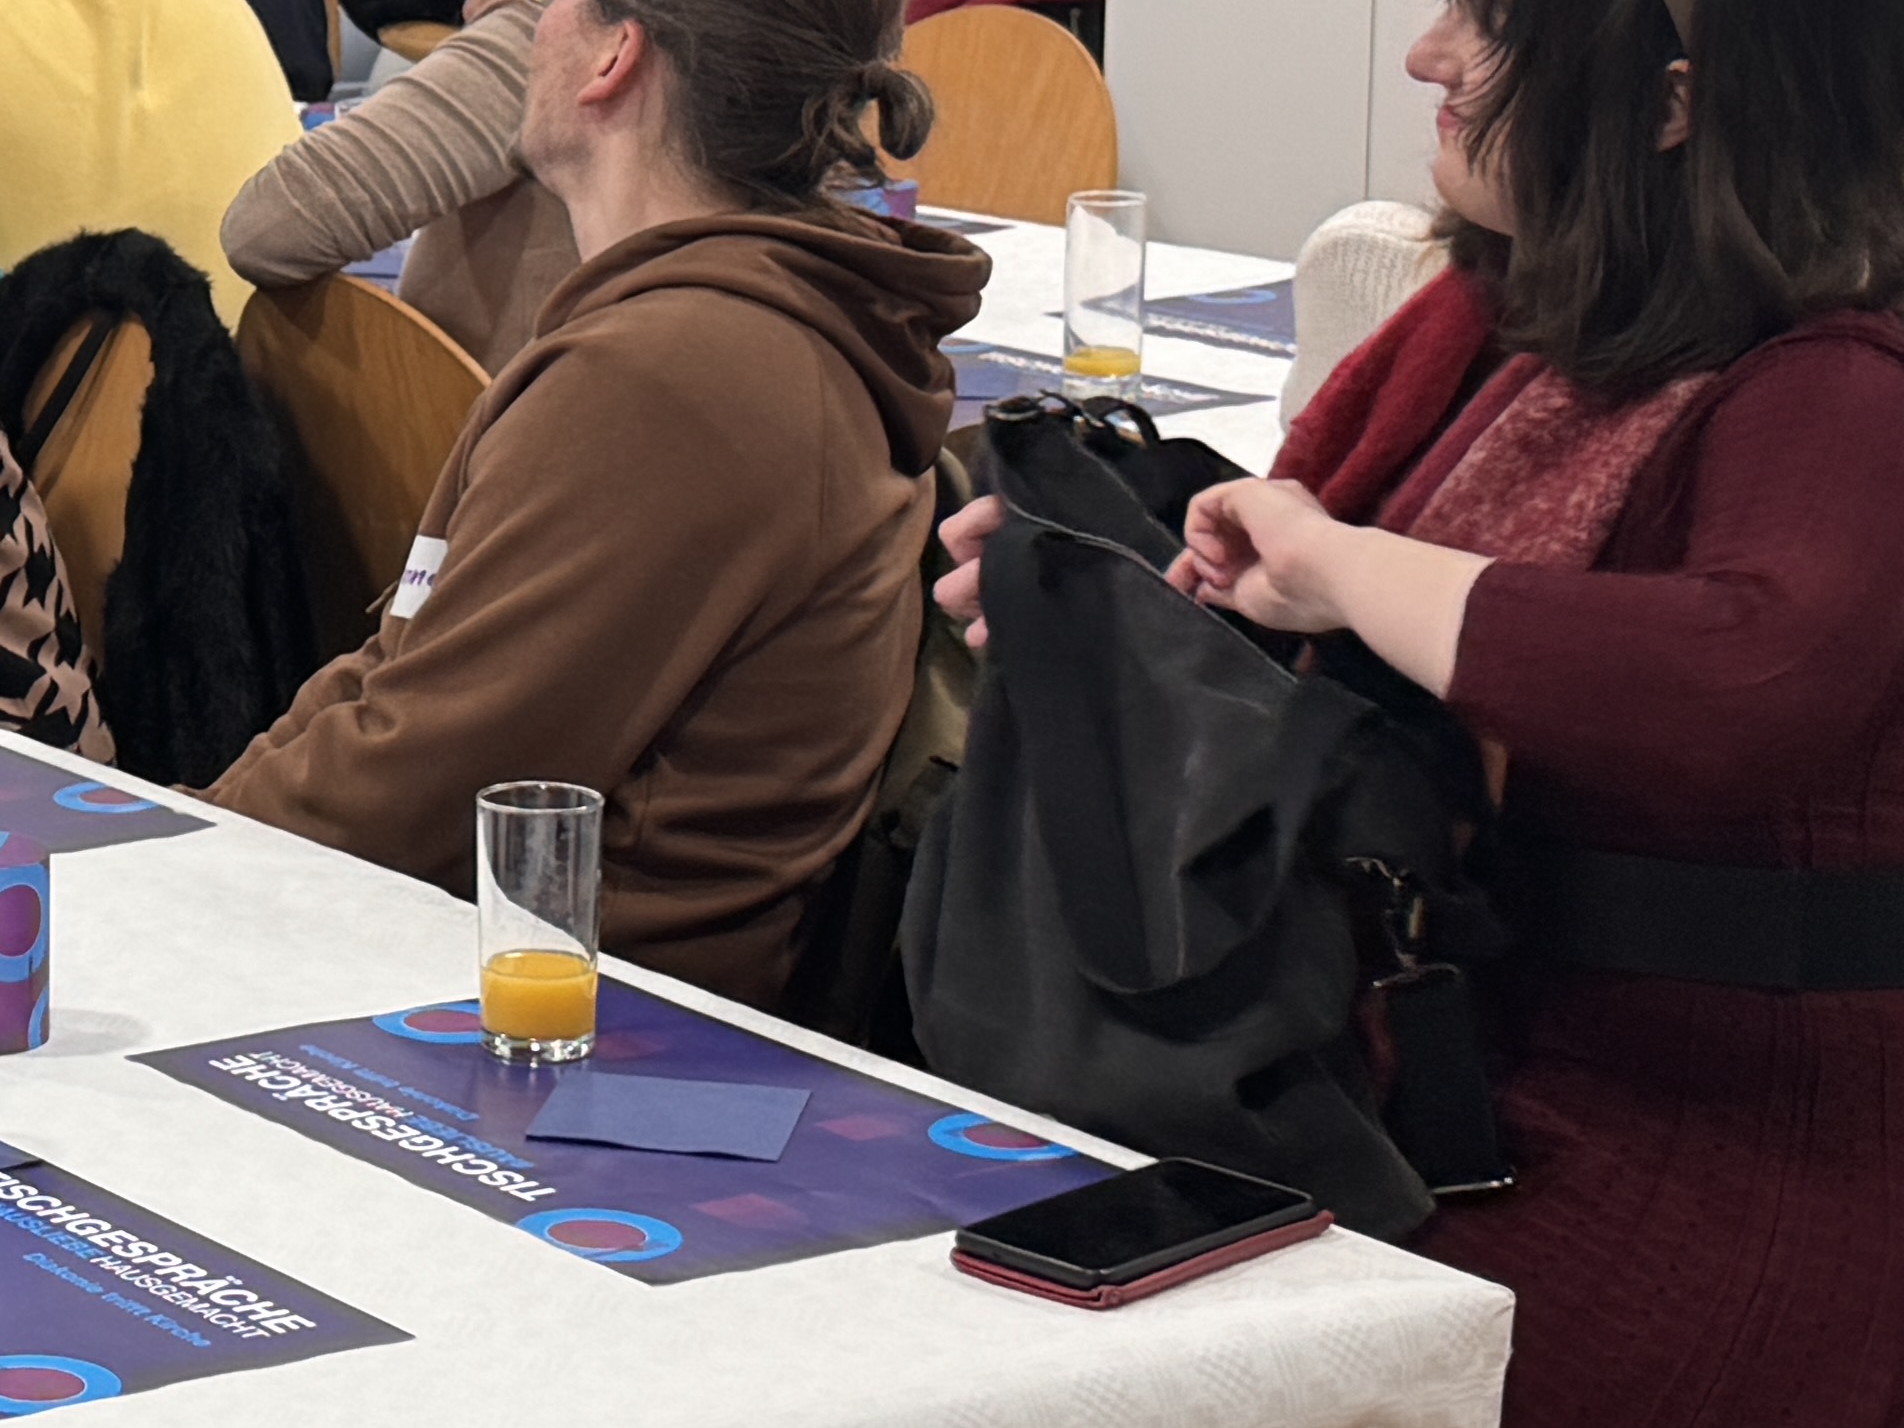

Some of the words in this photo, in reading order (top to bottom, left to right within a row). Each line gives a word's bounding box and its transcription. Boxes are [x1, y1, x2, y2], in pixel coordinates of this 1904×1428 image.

[208, 1053, 557, 1203] TISCHGESPRÄCHE
[251, 1050, 415, 1119] HAUSGEMACHT
[23, 1252, 104, 1295] Diakonie
[144, 1313, 212, 1349] Kirche
[90, 1255, 272, 1339] HAUSGEMACHT
